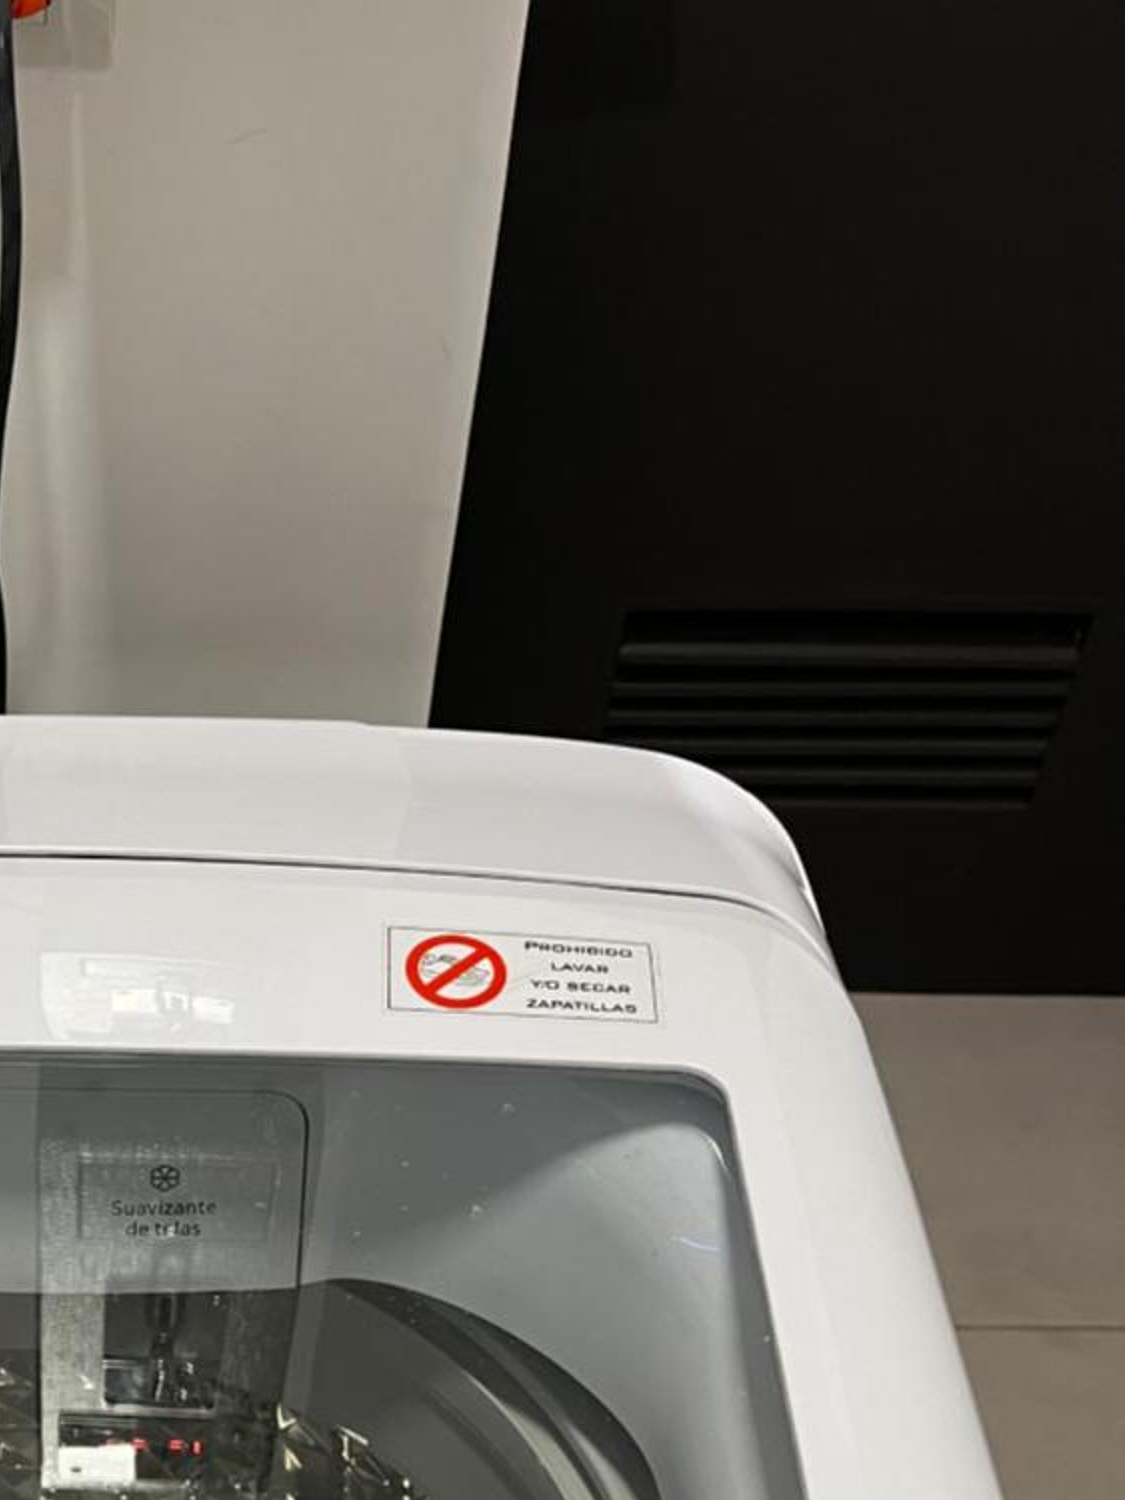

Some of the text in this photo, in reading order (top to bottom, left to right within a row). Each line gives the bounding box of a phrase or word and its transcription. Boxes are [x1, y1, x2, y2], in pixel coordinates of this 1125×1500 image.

[525, 941, 633, 958] PROHIBIDO
[551, 962, 609, 974] LAVAR
[531, 979, 631, 994] Y/O SECAR
[525, 998, 637, 1014] ZAPATILLAS
[111, 1199, 217, 1217] Suavizante
[125, 1221, 149, 1237] de
